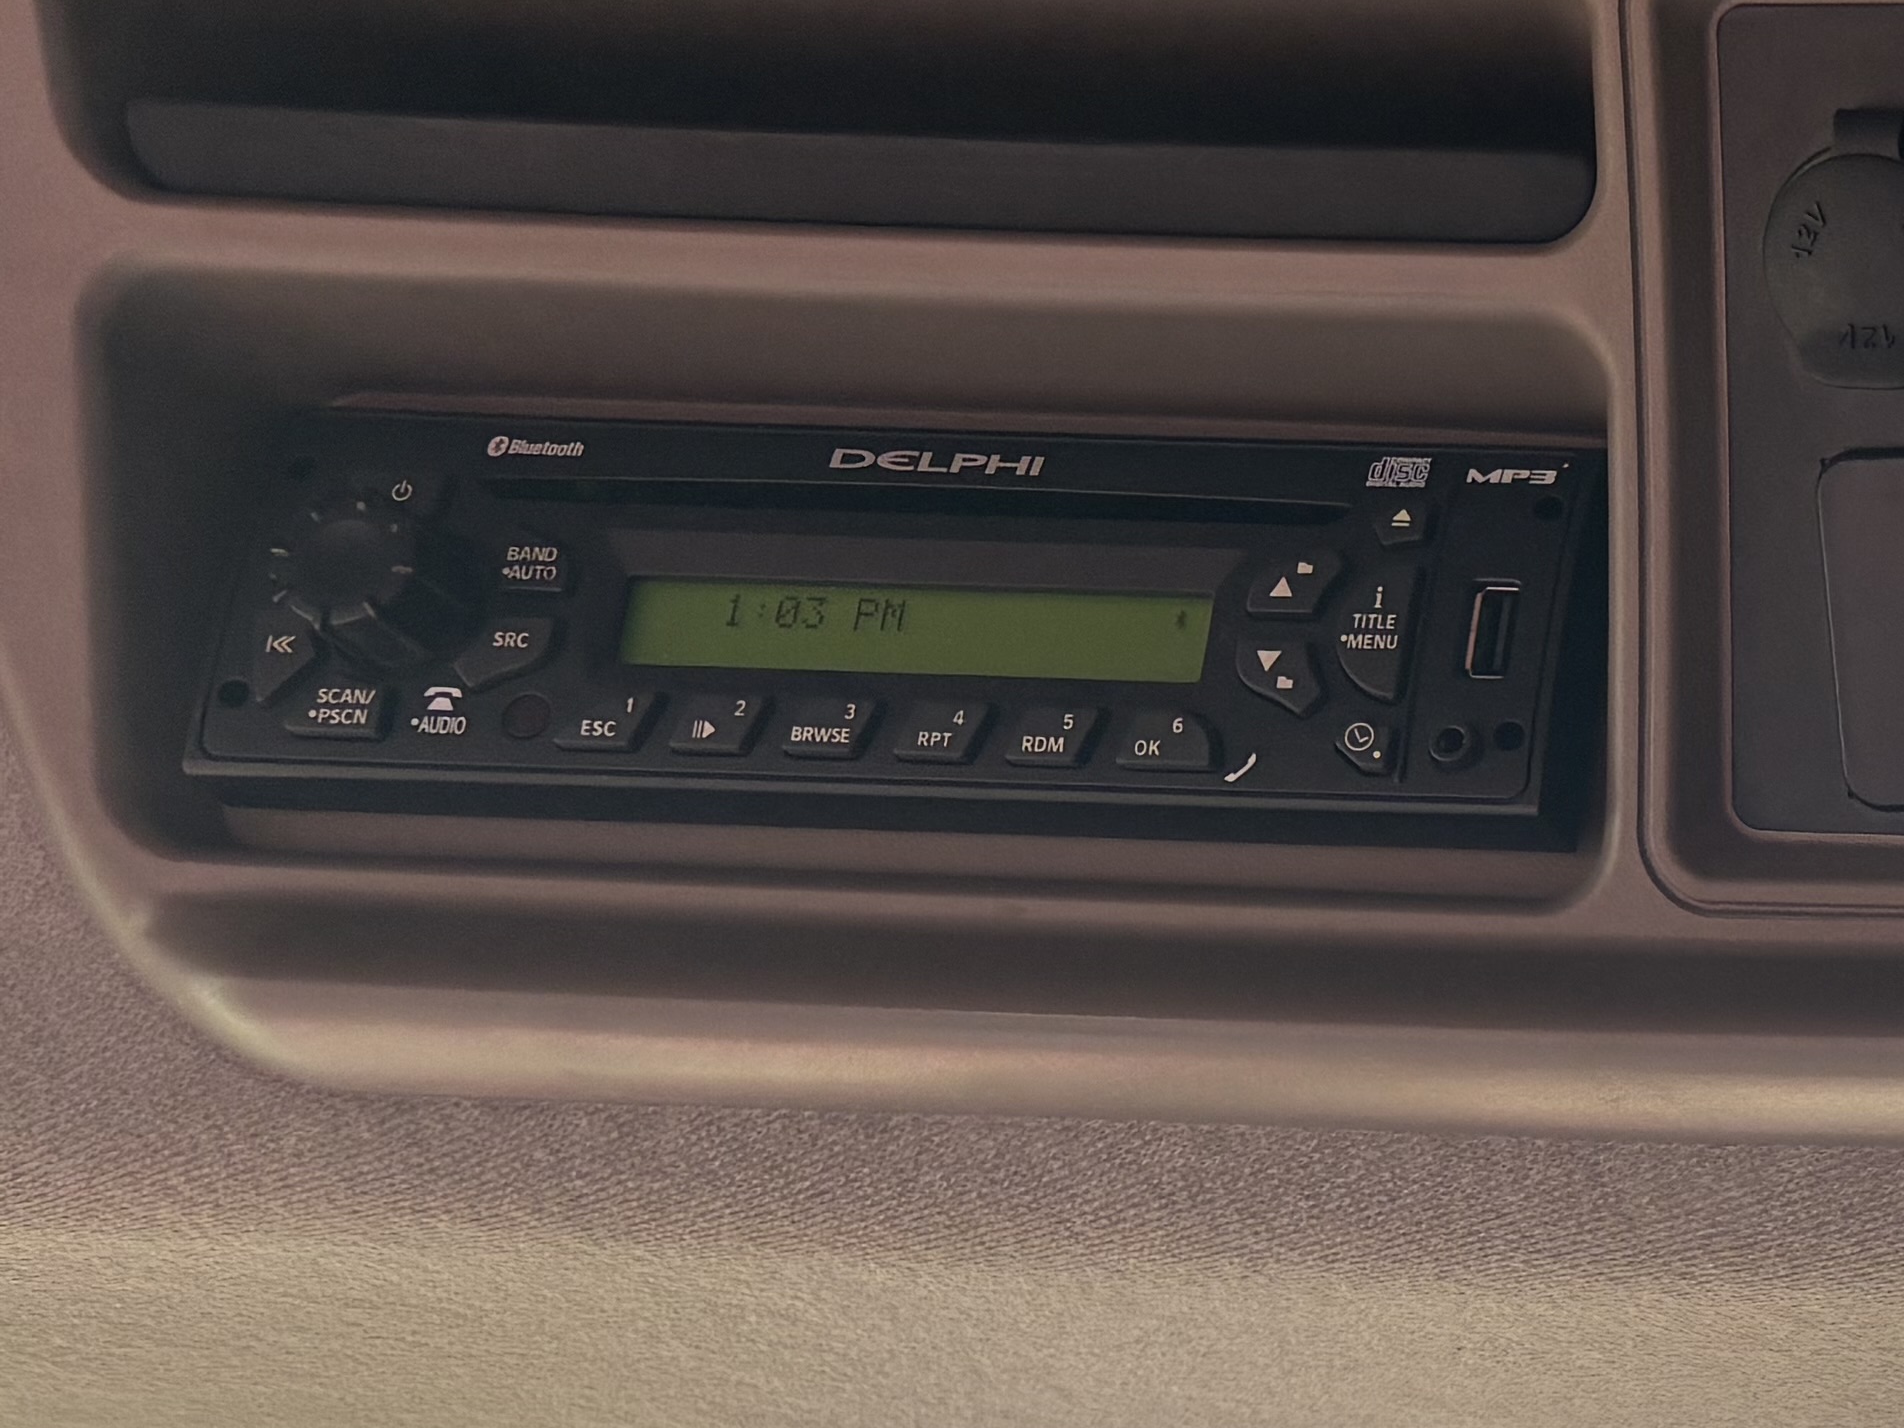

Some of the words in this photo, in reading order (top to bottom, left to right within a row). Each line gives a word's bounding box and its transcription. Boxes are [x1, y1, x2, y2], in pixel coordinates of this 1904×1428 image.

[509, 438, 584, 457] Bluetooth
[829, 449, 1045, 476] DELPHI
[1466, 468, 1557, 485] MP3
[507, 546, 557, 563] BAND
[726, 594, 826, 629] 1:03
[854, 599, 909, 633] PM
[1353, 614, 1397, 630] TITLE
[493, 632, 529, 648] SRC
[626, 698, 634, 713] 1
[735, 700, 746, 716] 2
[845, 703, 855, 720] 3
[953, 709, 964, 725] 4
[1063, 713, 1074, 729] 5
[580, 719, 616, 737] ESC
[1173, 718, 1183, 734] 6
[790, 726, 851, 744] BRWSE
[917, 731, 953, 747] RPT
[1021, 736, 1065, 753] RDM
[1134, 740, 1161, 756] OK
